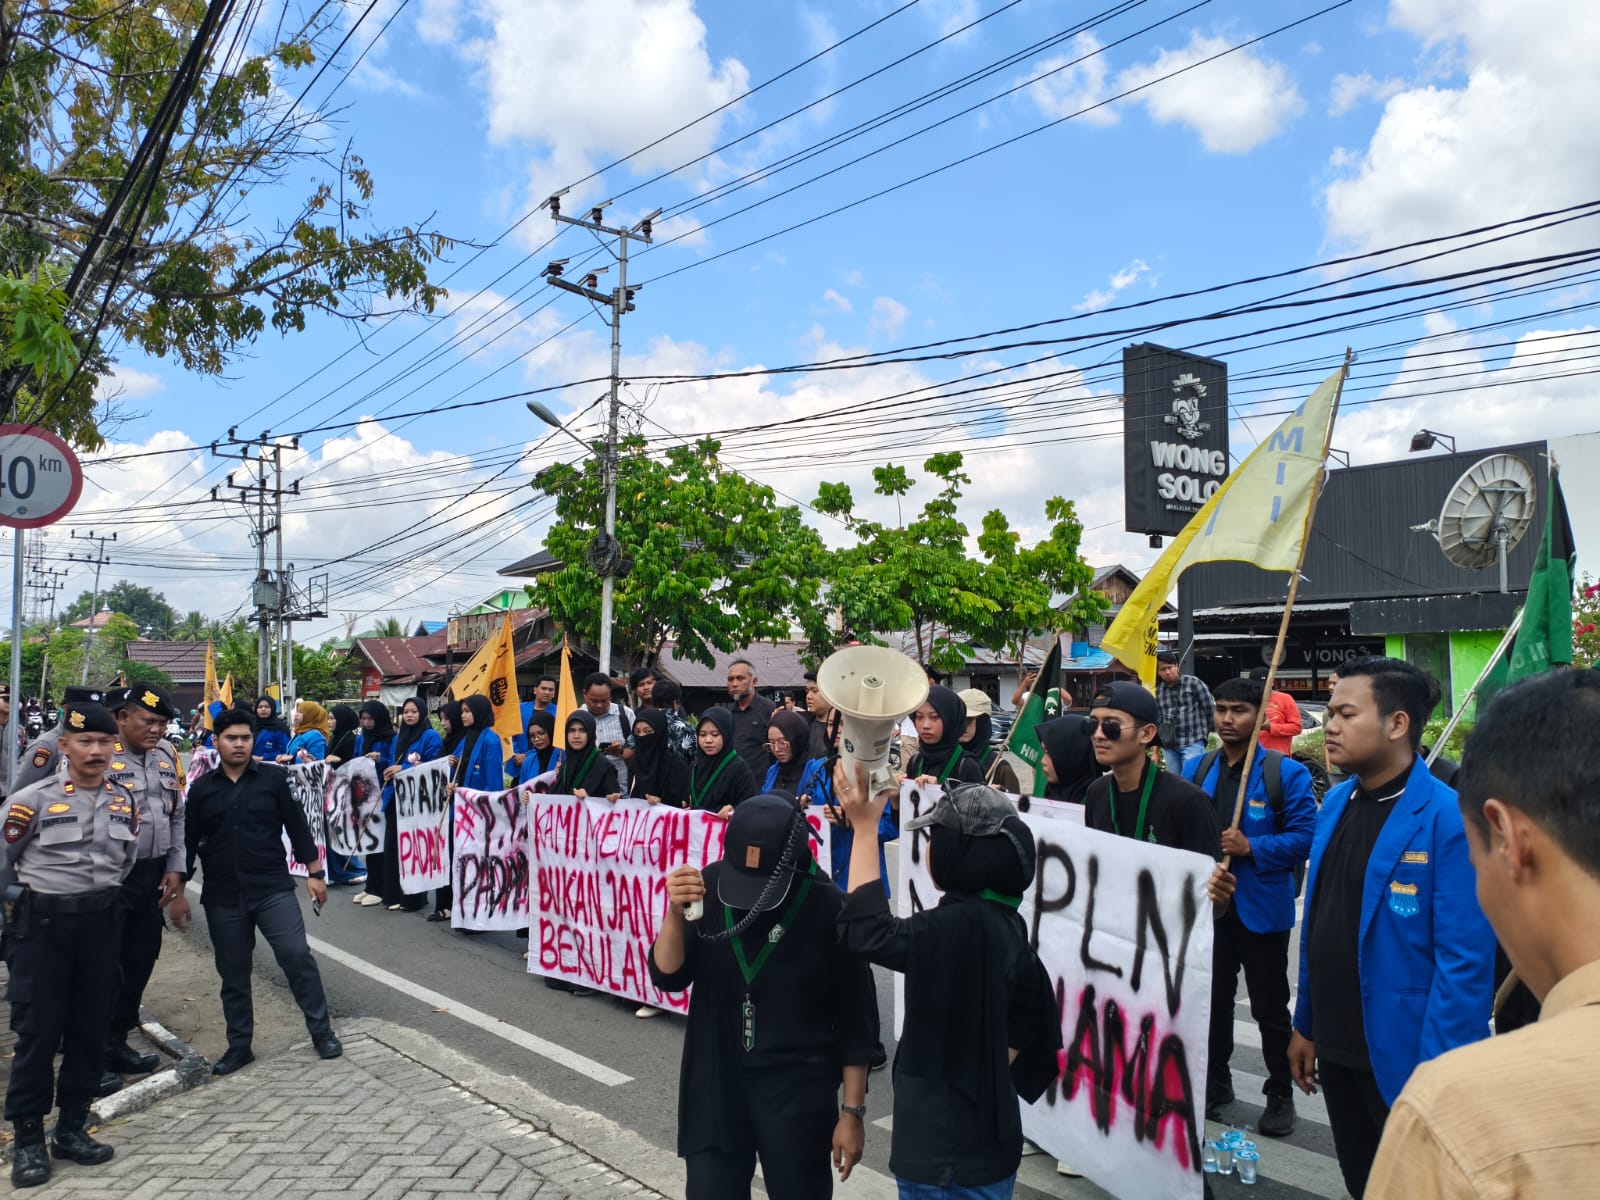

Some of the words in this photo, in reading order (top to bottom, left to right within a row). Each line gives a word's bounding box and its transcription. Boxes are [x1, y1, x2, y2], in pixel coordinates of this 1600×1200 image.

[0, 455, 36, 500] 0
[39, 454, 63, 473] km
[1150, 440, 1226, 476] WONG
[1303, 649, 1357, 663] WONG
[534, 801, 582, 861] KAMI
[586, 807, 689, 872] MENAGIH
[538, 865, 602, 928] BUKAN
[1030, 837, 1197, 1018] PLN
